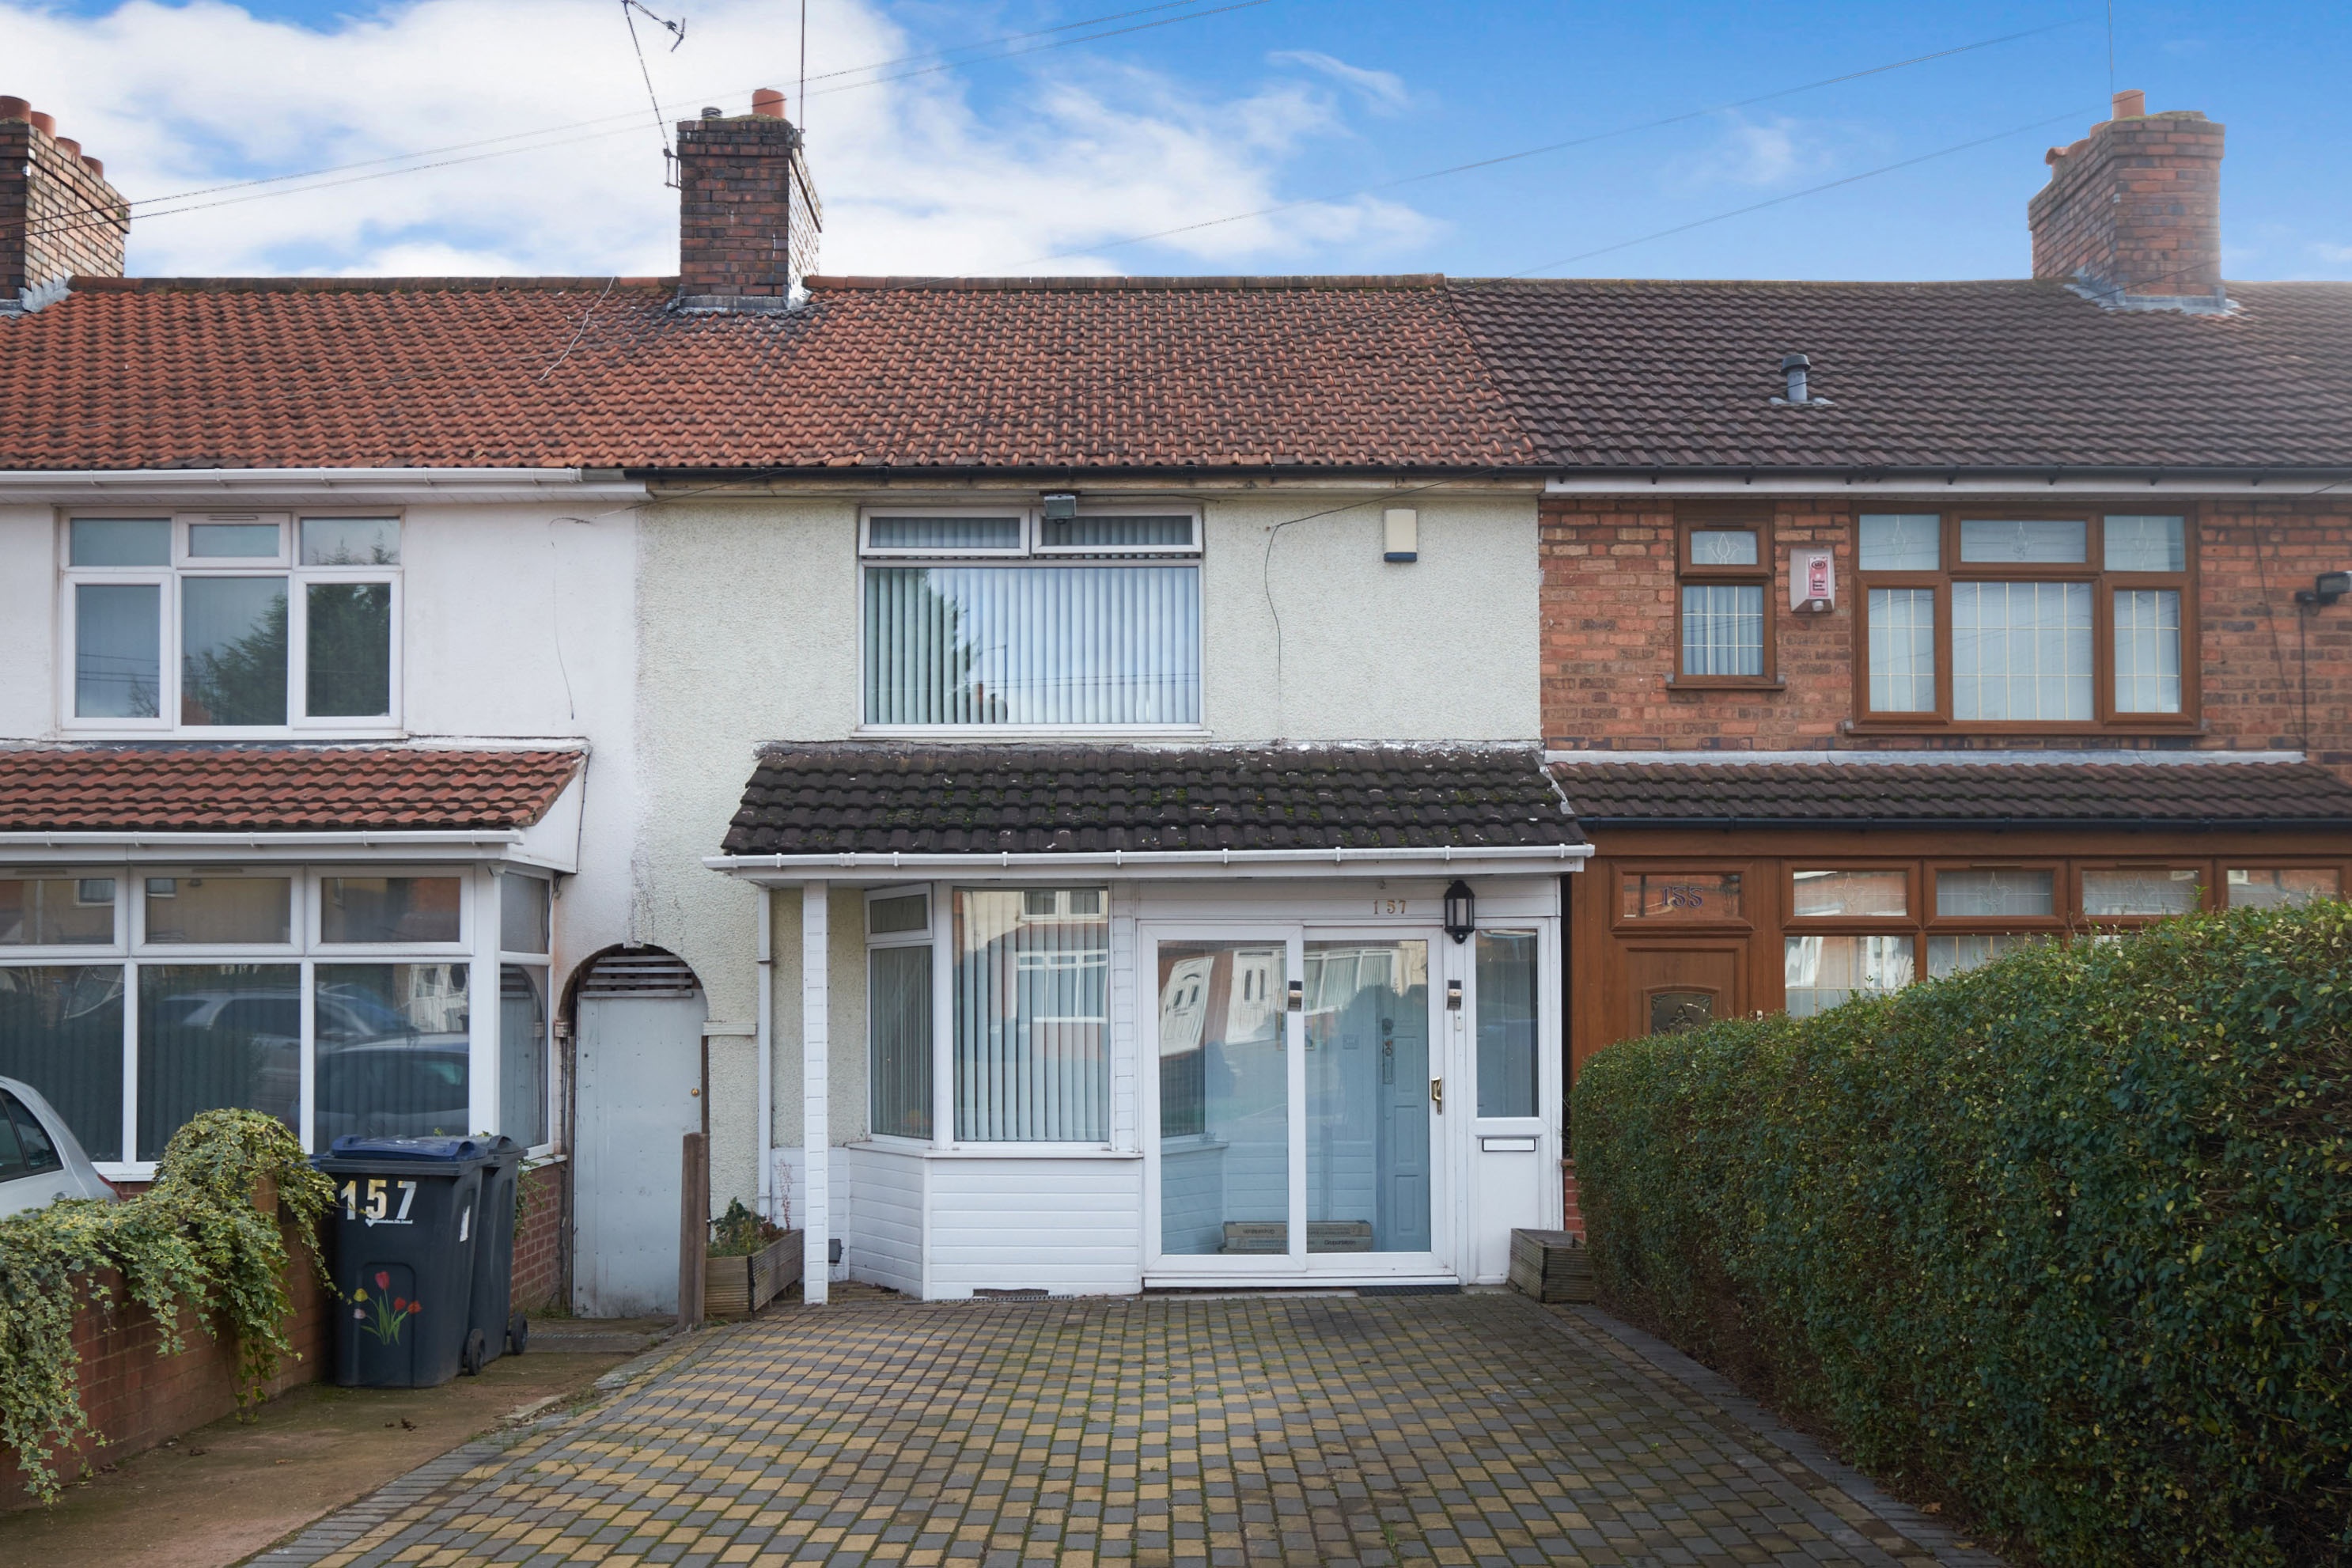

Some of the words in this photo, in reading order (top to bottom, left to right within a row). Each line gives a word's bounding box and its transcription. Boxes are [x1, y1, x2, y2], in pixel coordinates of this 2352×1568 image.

[1373, 899, 1407, 915] 157
[1661, 886, 1703, 907] 155
[340, 1179, 418, 1221] 157
